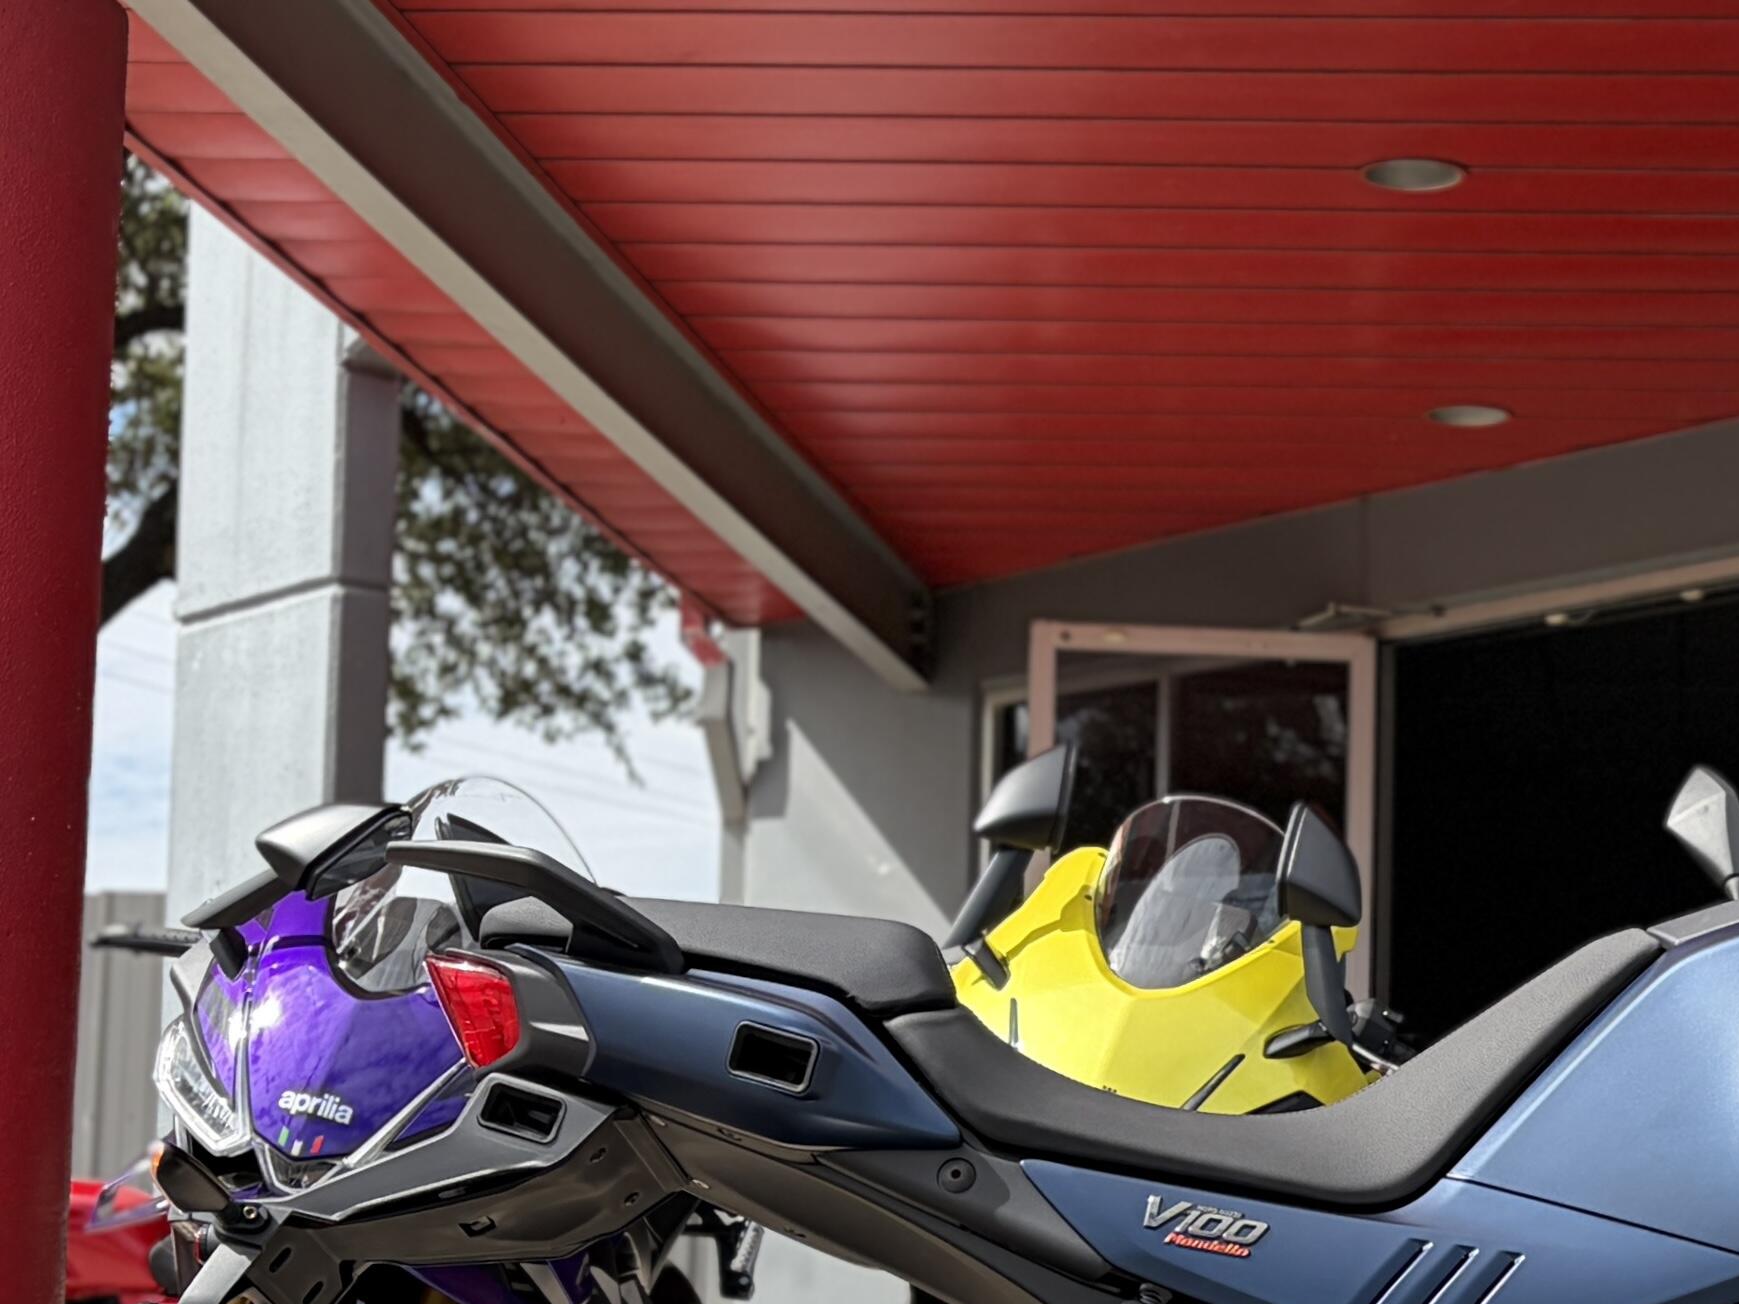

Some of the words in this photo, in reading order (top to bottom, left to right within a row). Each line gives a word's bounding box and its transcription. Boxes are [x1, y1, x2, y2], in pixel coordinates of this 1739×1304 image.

[278, 1090, 353, 1125] aprilia
[1143, 1194, 1268, 1245] V100
[1163, 1232, 1250, 1257] Mandello
